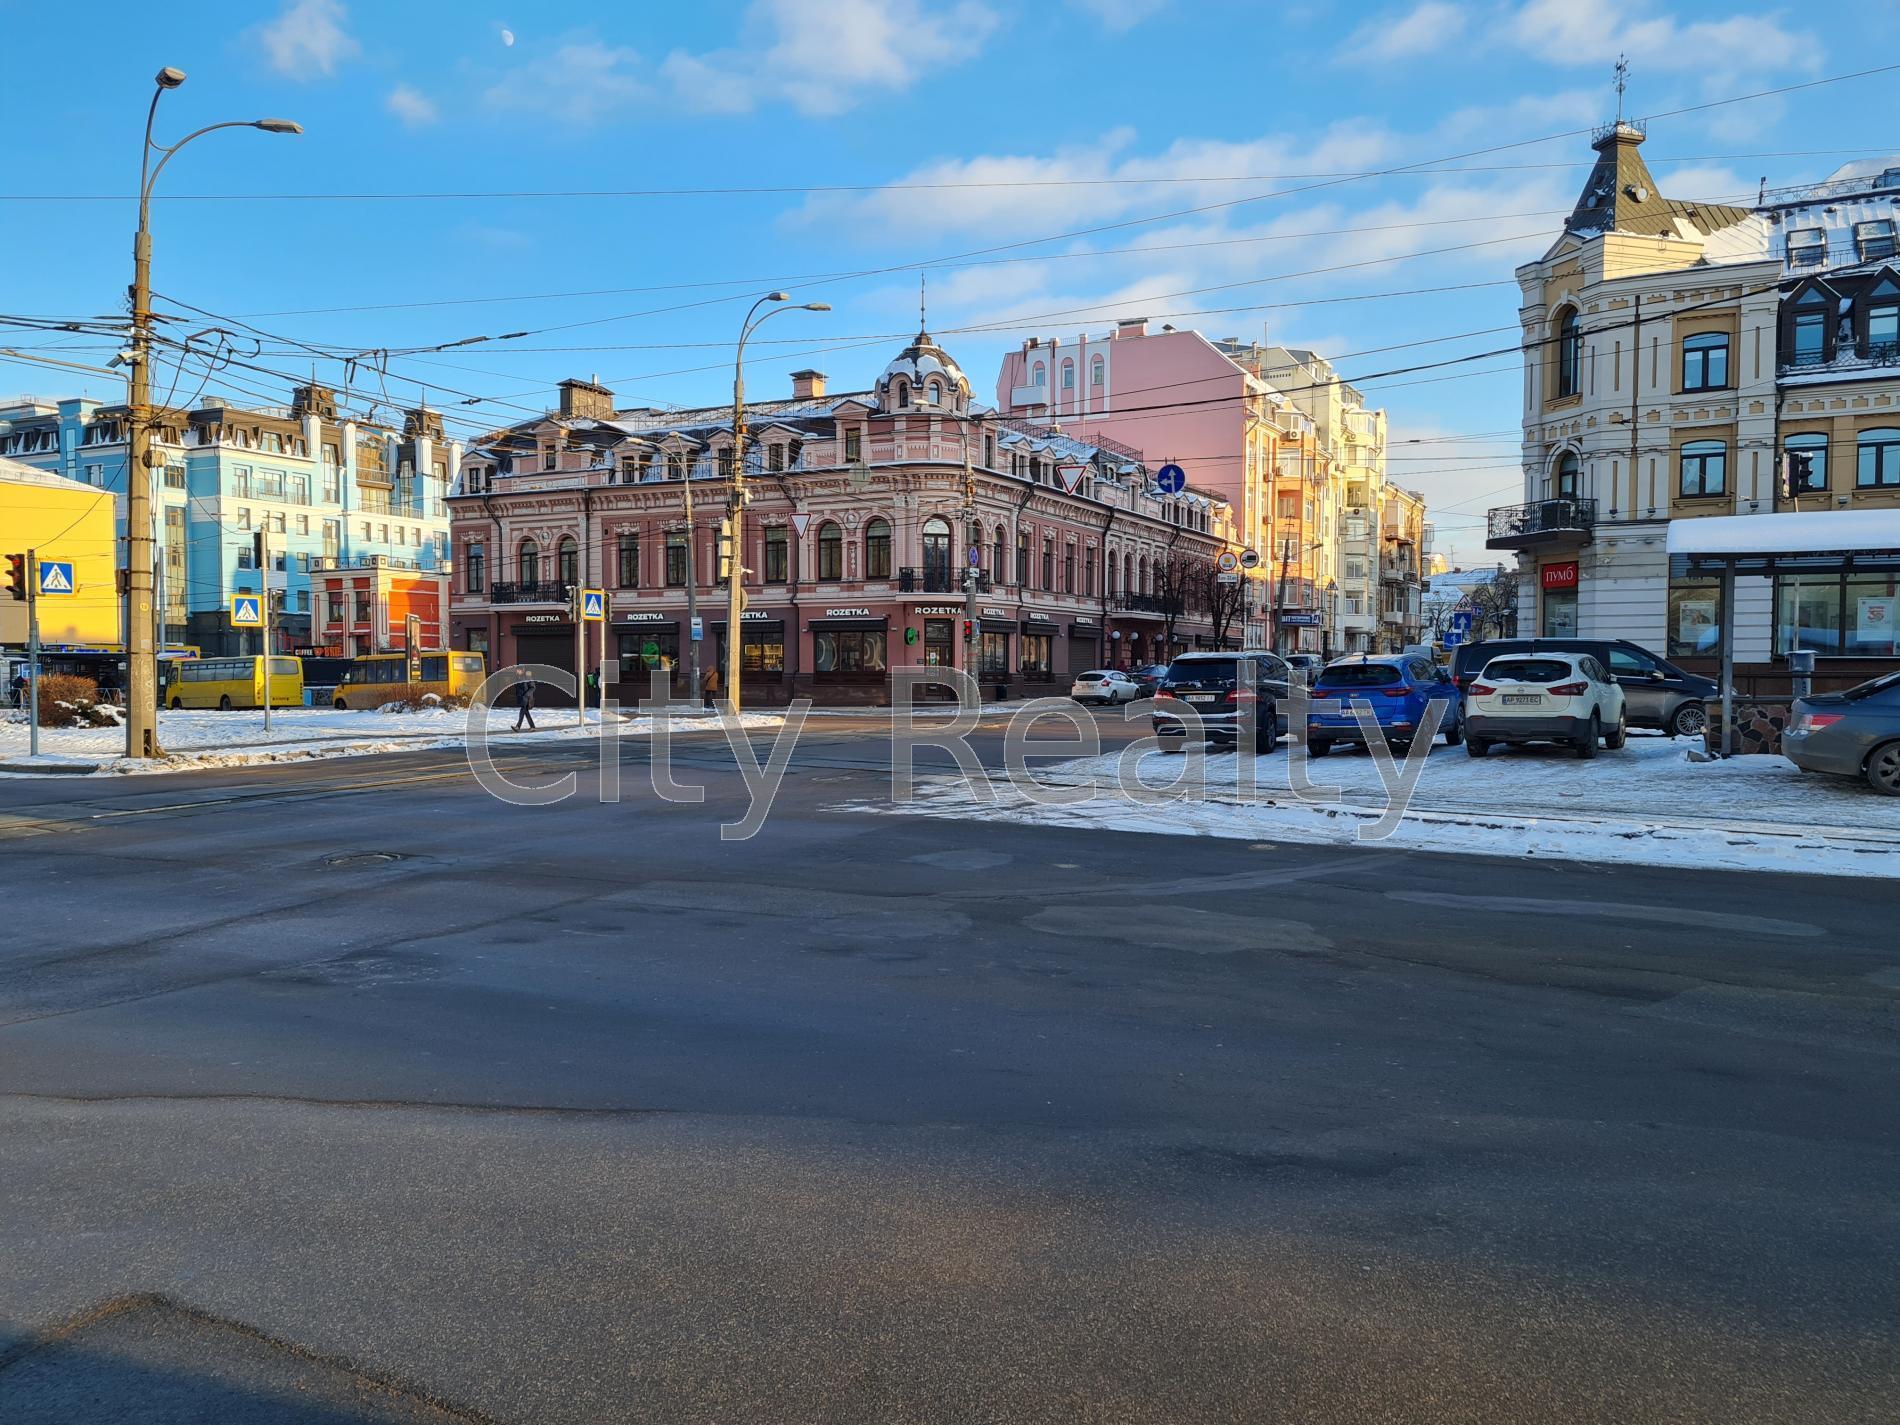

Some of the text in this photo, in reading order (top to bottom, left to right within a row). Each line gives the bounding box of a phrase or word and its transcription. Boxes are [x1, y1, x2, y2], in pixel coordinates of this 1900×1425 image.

[740, 611, 768, 619] ZETKA
[826, 608, 870, 616] ROZETKA
[914, 607, 962, 615] ROZETKA
[983, 607, 1005, 616] ROZETKA
[627, 613, 664, 621] ROZETKA
[1029, 612, 1050, 621] ROZETKA
[1075, 616, 1094, 624] ROZETKA
[294, 648, 313, 656] COFFEE
